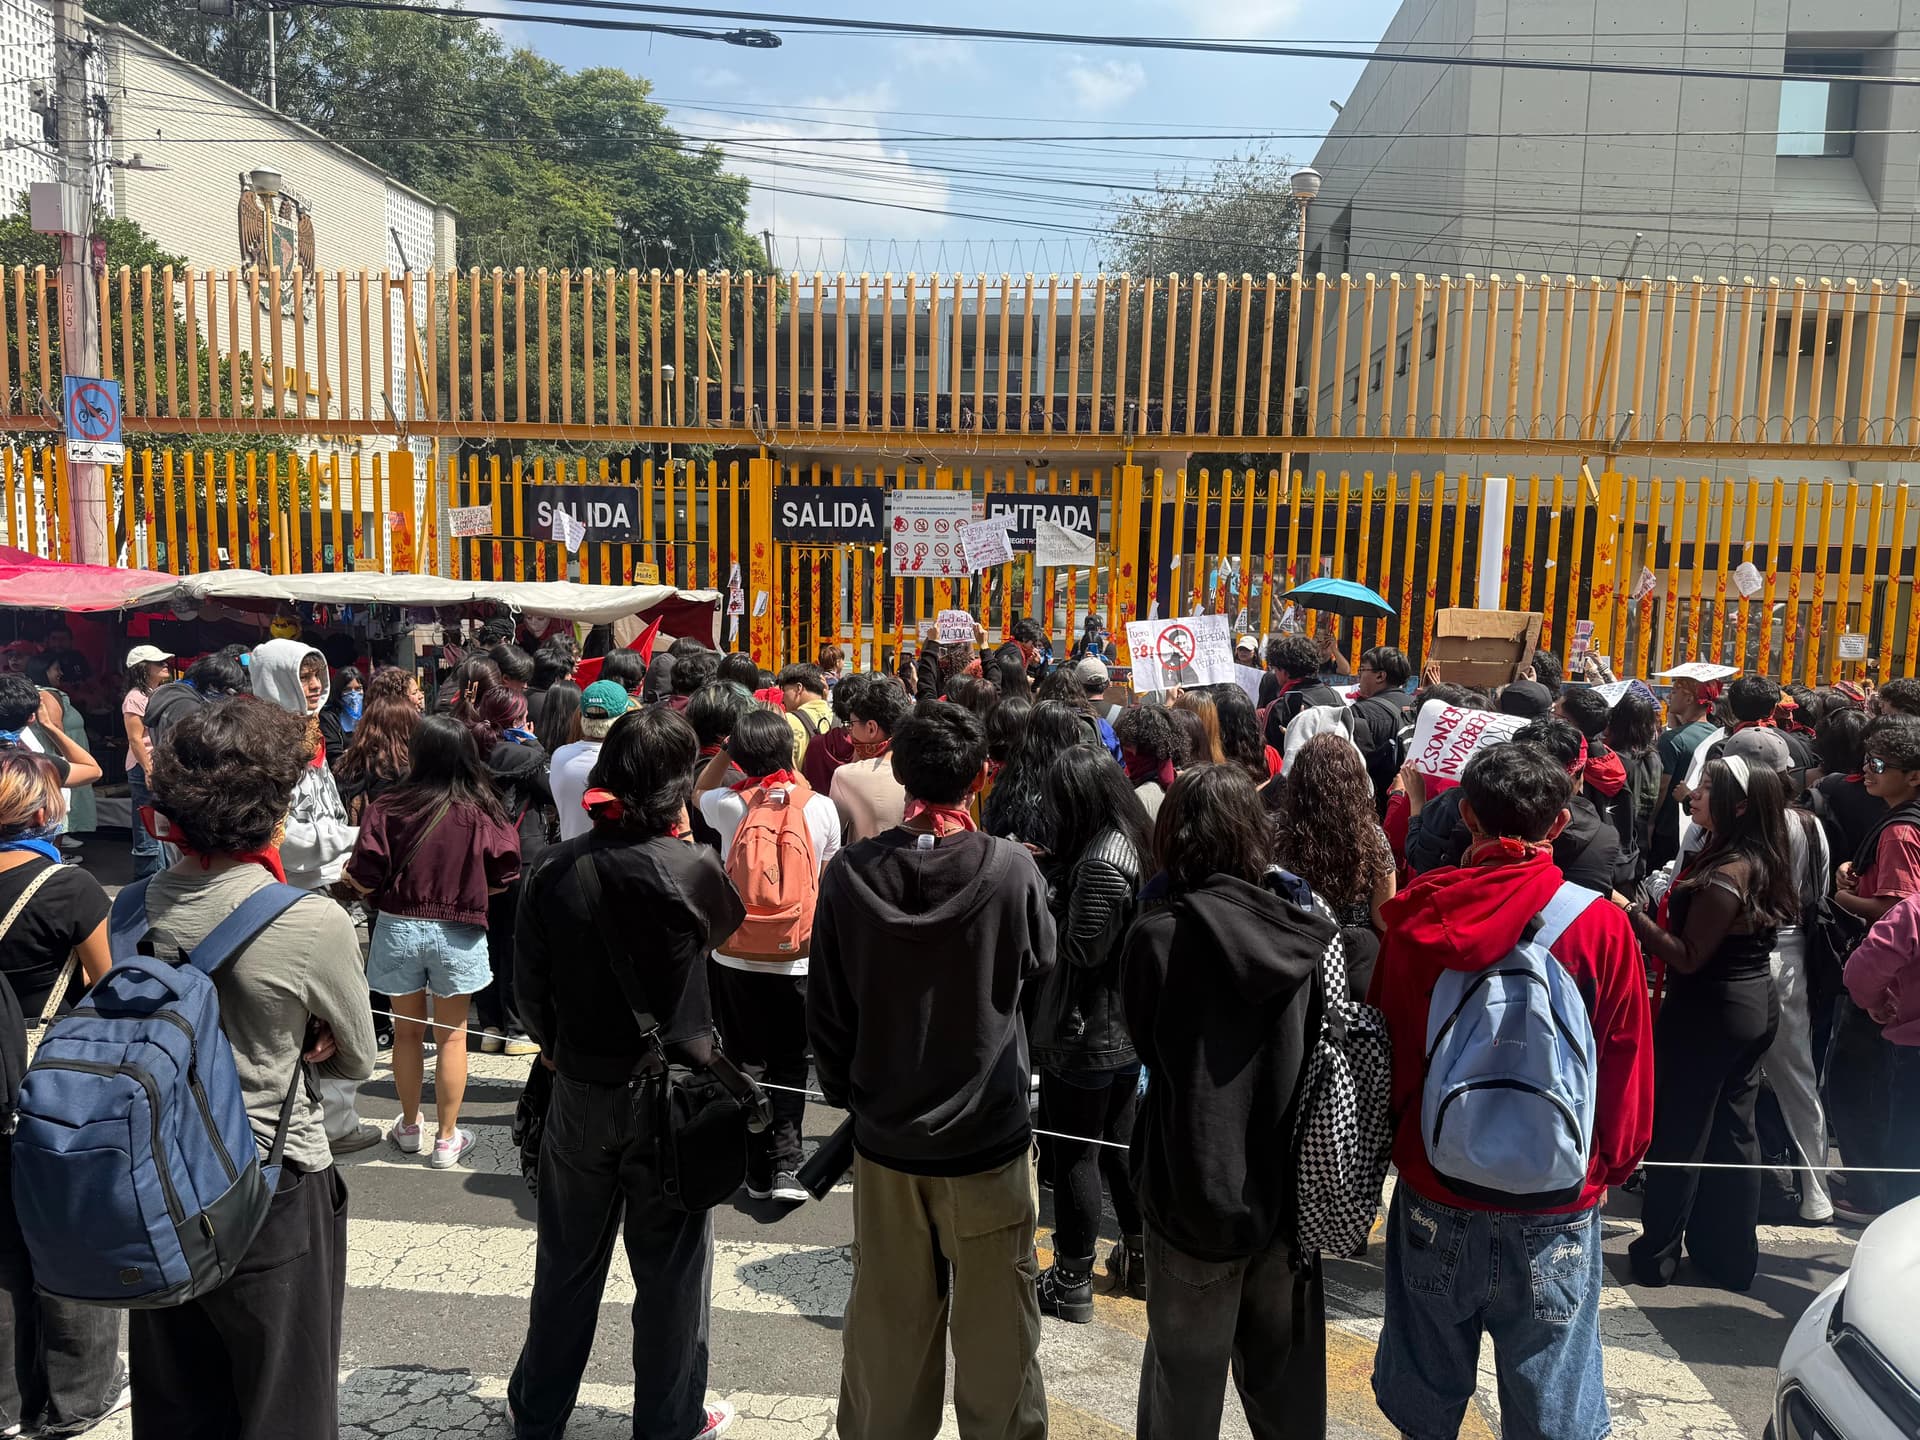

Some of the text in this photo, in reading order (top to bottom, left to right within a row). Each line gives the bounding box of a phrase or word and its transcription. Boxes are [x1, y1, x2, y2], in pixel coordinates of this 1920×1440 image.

[782, 502, 875, 528] SALIDA
[991, 504, 1092, 531] ENTRADA
[1439, 713, 1496, 775] DEBERIAN
